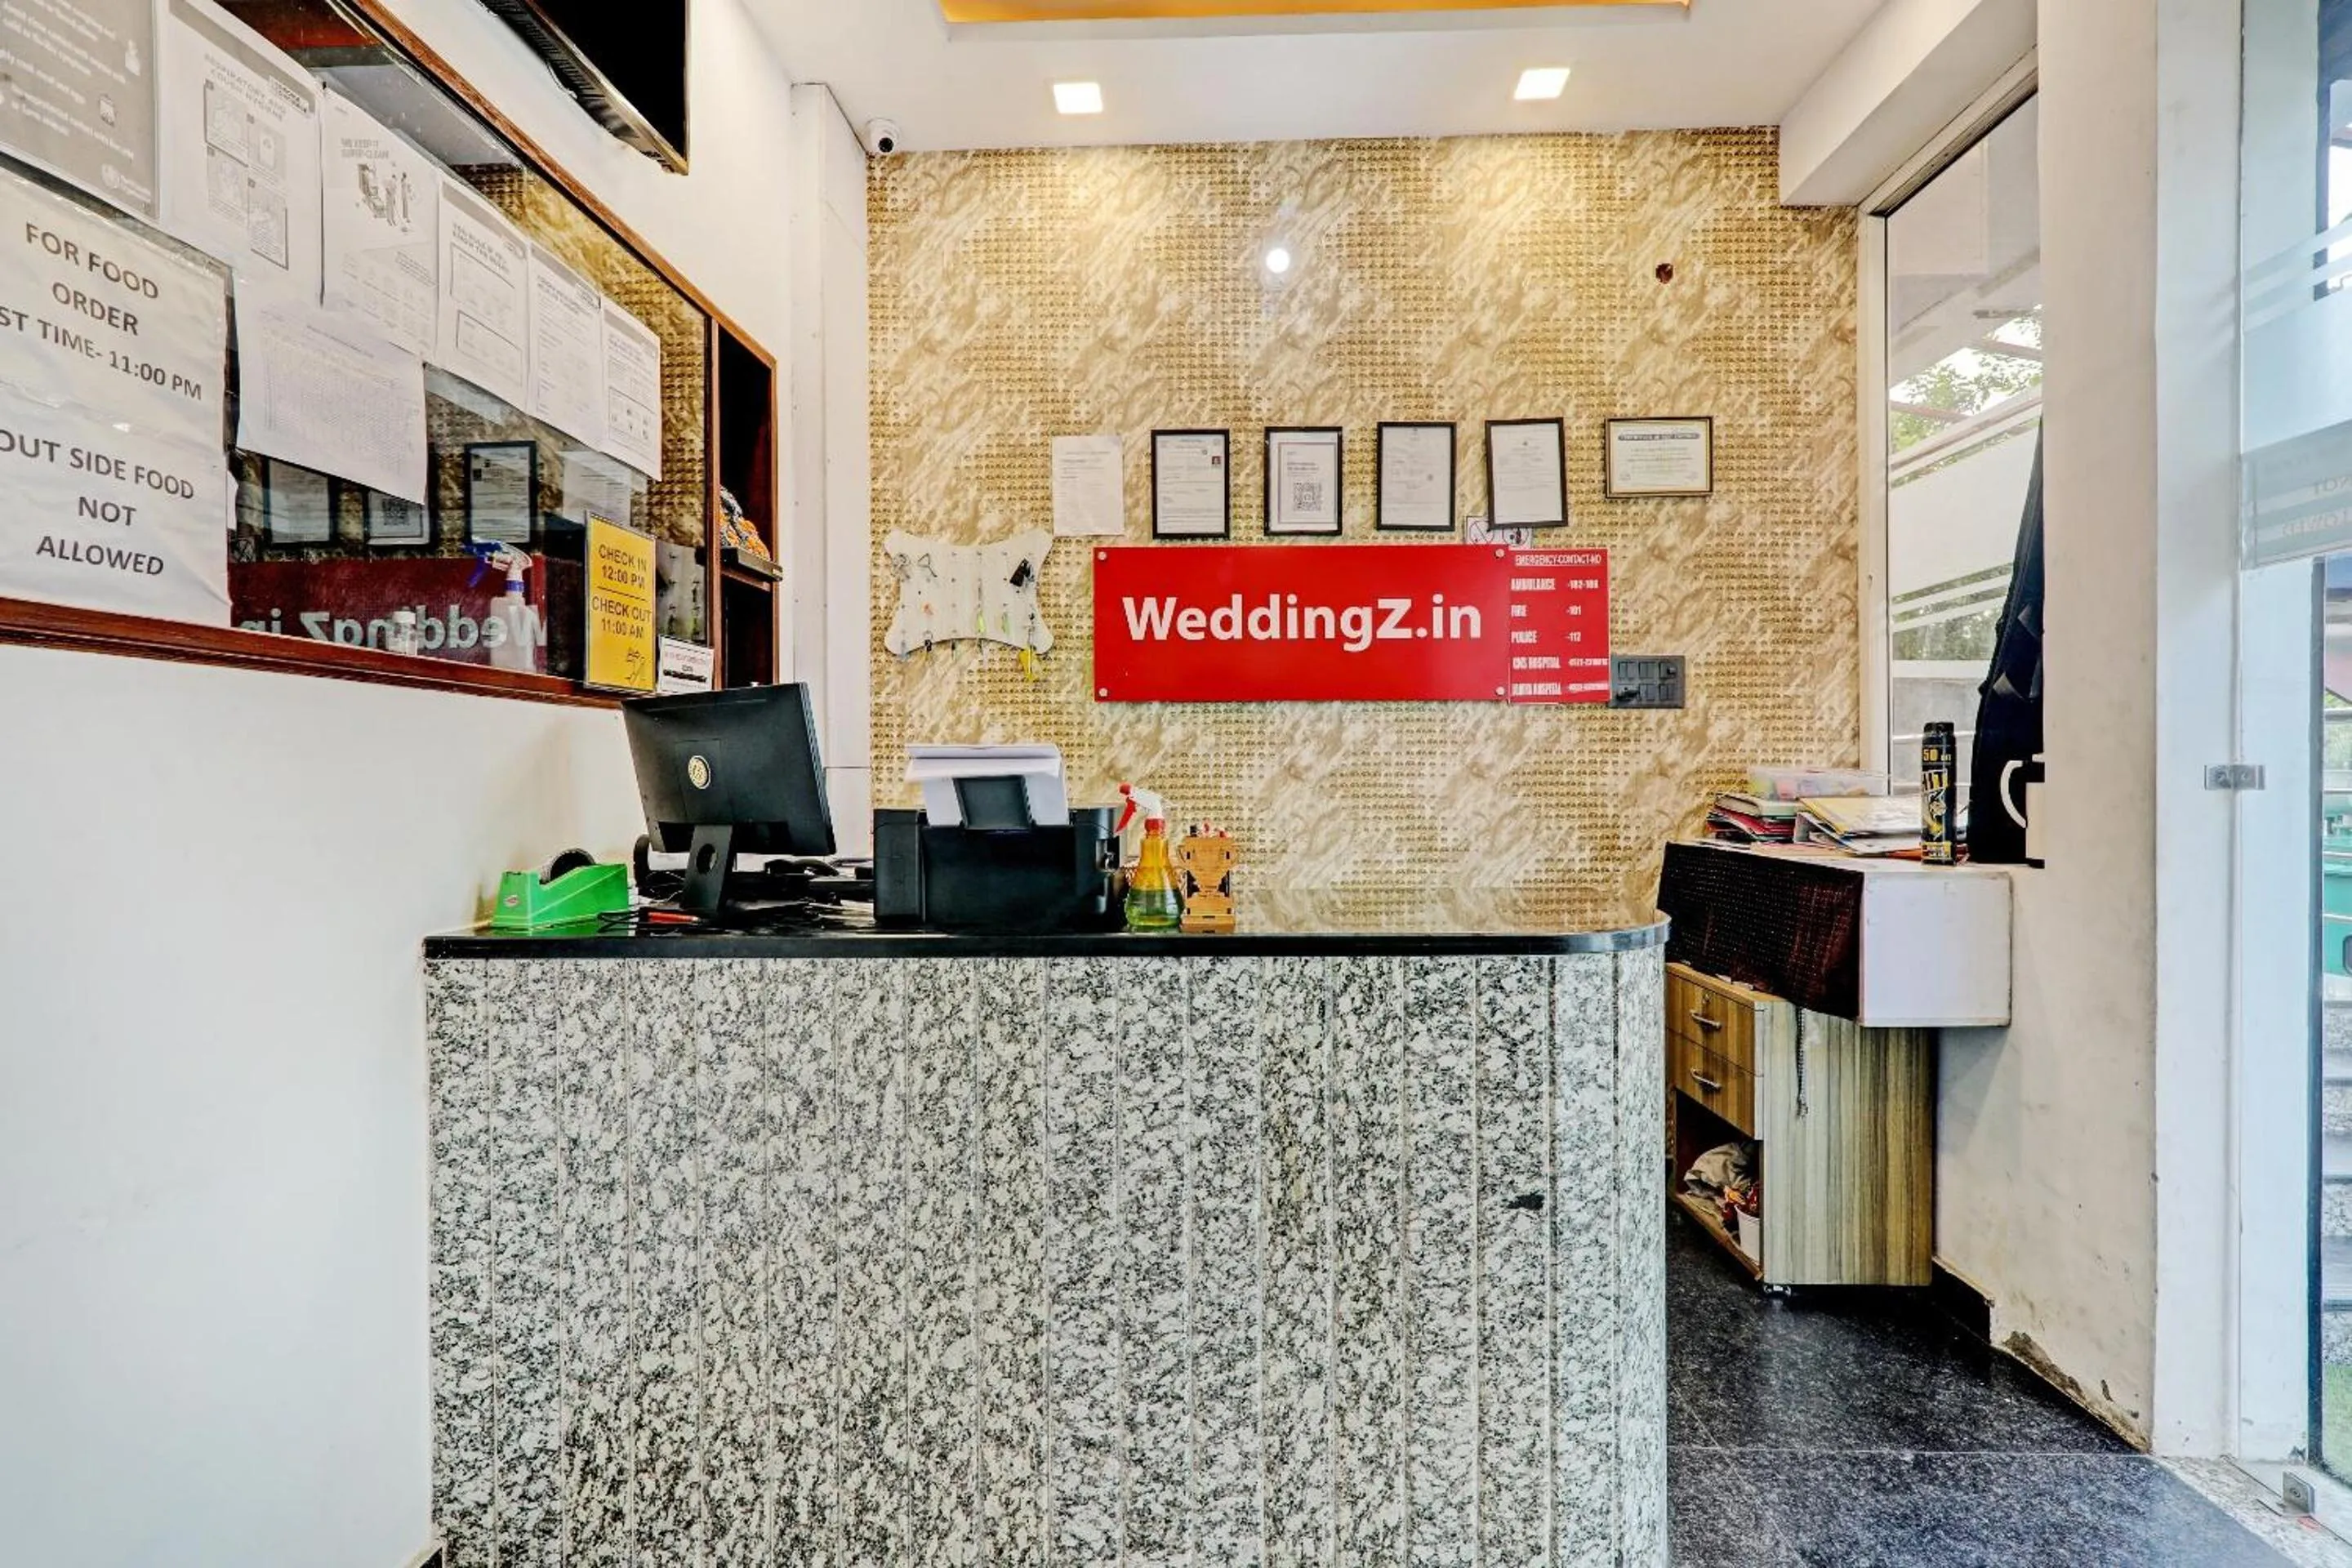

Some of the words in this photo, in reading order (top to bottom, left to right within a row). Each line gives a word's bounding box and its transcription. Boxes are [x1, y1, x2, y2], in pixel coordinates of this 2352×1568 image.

[26, 221, 79, 265] FOR
[88, 252, 158, 299] FOOD
[52, 282, 139, 336] ORDER
[0, 306, 29, 332] ST
[38, 318, 102, 359] TIME-
[109, 350, 165, 385] 11:00
[172, 375, 202, 400] PM
[69, 448, 126, 480] SIDE
[135, 466, 194, 500] FOOD
[78, 497, 136, 526] NOT
[36, 536, 163, 576] ALLOWED
[599, 544, 635, 568] CHECK
[638, 557, 646, 572] IN
[602, 565, 628, 584] 12:00
[592, 596, 629, 618] CHECK
[632, 607, 653, 621] OUT
[1122, 594, 1481, 653] WeddingZ.in
